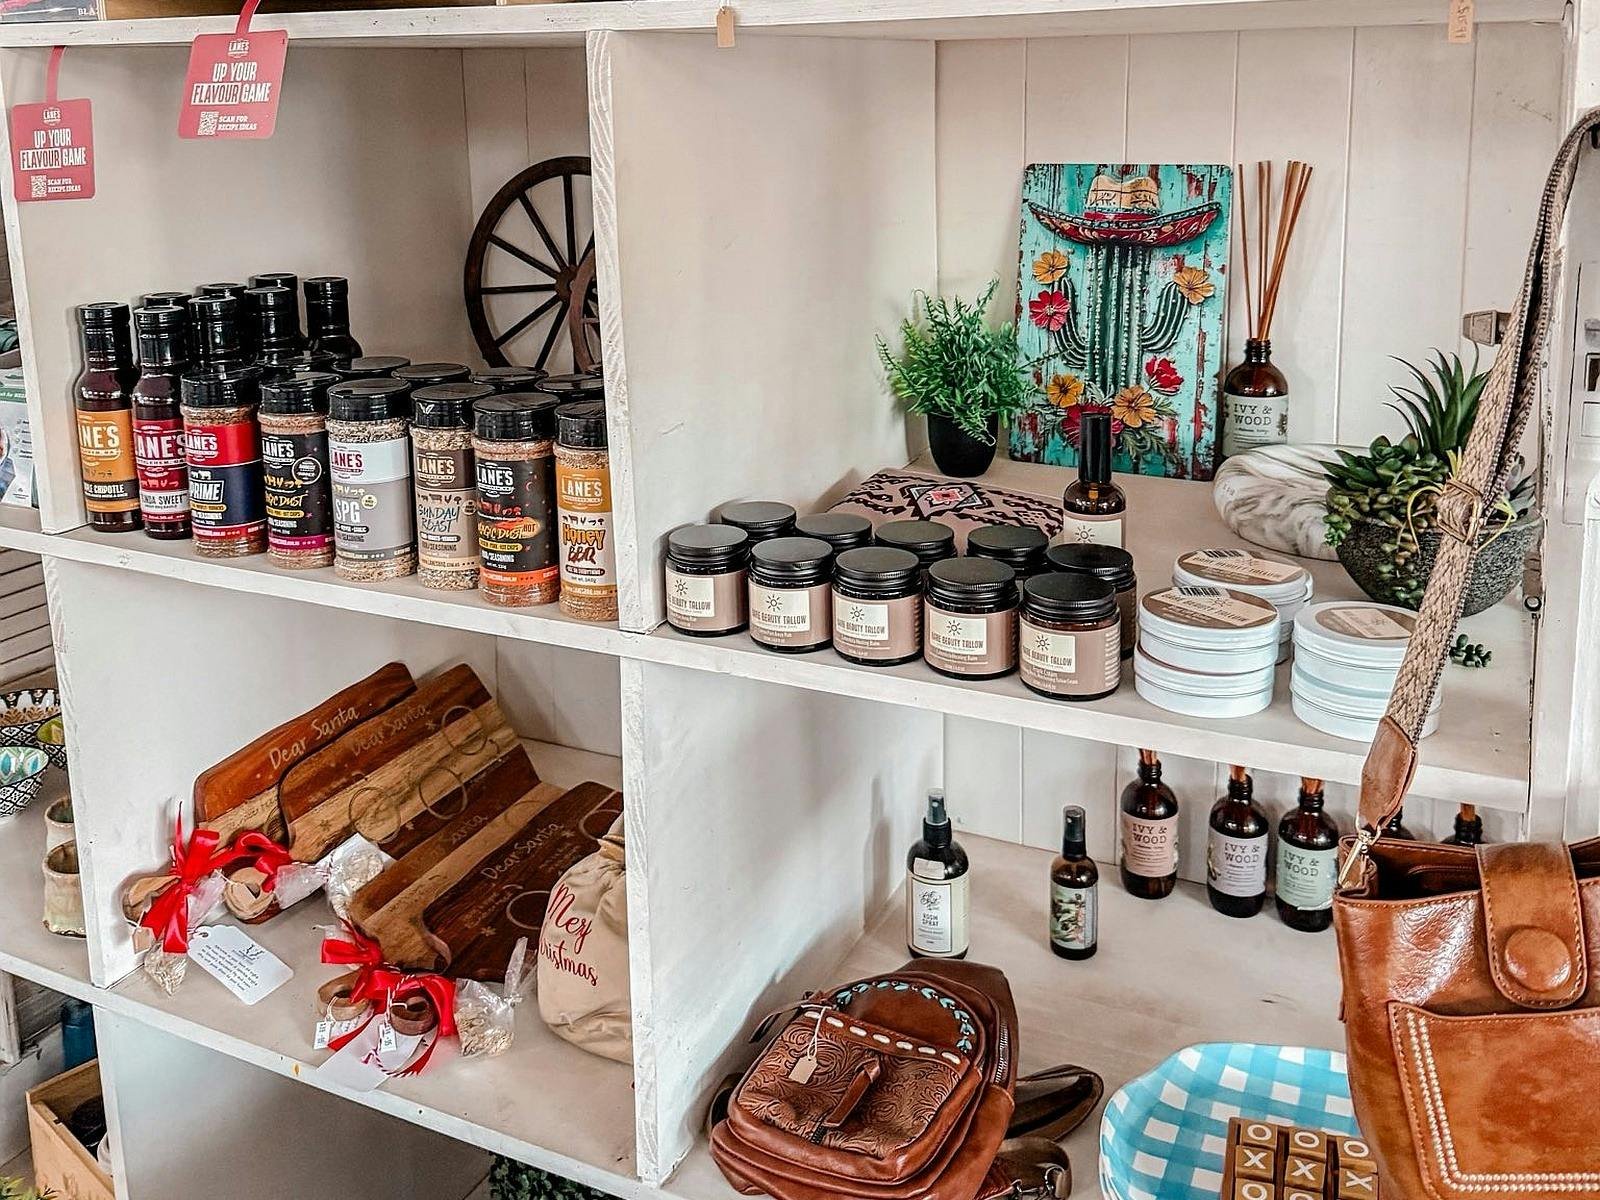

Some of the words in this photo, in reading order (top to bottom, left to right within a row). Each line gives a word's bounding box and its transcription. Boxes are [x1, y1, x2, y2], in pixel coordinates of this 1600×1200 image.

[212, 63, 227, 82] UP
[230, 62, 257, 81] YOUR
[193, 84, 239, 104] FLAVOUR
[241, 83, 272, 103] GAME
[34, 131, 46, 148] UP
[48, 128, 72, 147] YOUR
[21, 150, 60, 169] FLAVOUR
[62, 147, 86, 166] GAME
[1234, 403, 1257, 414] IVY
[1262, 405, 1272, 414] &
[1234, 414, 1271, 425] WOOD
[417, 456, 455, 475] LANE'S
[476, 464, 514, 486] LANE'S
[94, 484, 124, 494] CHIPOTLE
[561, 476, 602, 497] LANE'S
[159, 494, 183, 505] SWEET
[335, 500, 361, 523] SPG
[418, 503, 460, 522] SUNDAY
[421, 519, 455, 533] ROAST
[523, 523, 536, 533] HOT
[562, 523, 605, 549] Honey
[567, 546, 596, 564] BBQ
[689, 600, 711, 611] TALLOW
[762, 612, 781, 624] BEAUTY
[783, 615, 806, 625] TALLOW
[846, 621, 863, 633] BEAUTY
[865, 624, 885, 634] TALLOW
[942, 635, 960, 647] BEAUTY
[962, 639, 984, 649] TALLOW
[1032, 650, 1048, 663] BEAUTY
[1050, 655, 1072, 666] TALLOW
[382, 703, 431, 737] Santa
[269, 736, 307, 770] Dear
[310, 706, 360, 741] Santa
[1132, 823, 1154, 834] IVY
[1132, 832, 1167, 844] WOOD
[480, 846, 521, 881] Dear
[514, 822, 564, 855] Santa
[1224, 842, 1247, 854] IVY
[1224, 852, 1260, 864] WOOD
[1284, 851, 1306, 865] IVY
[1284, 859, 1319, 876] WOOD
